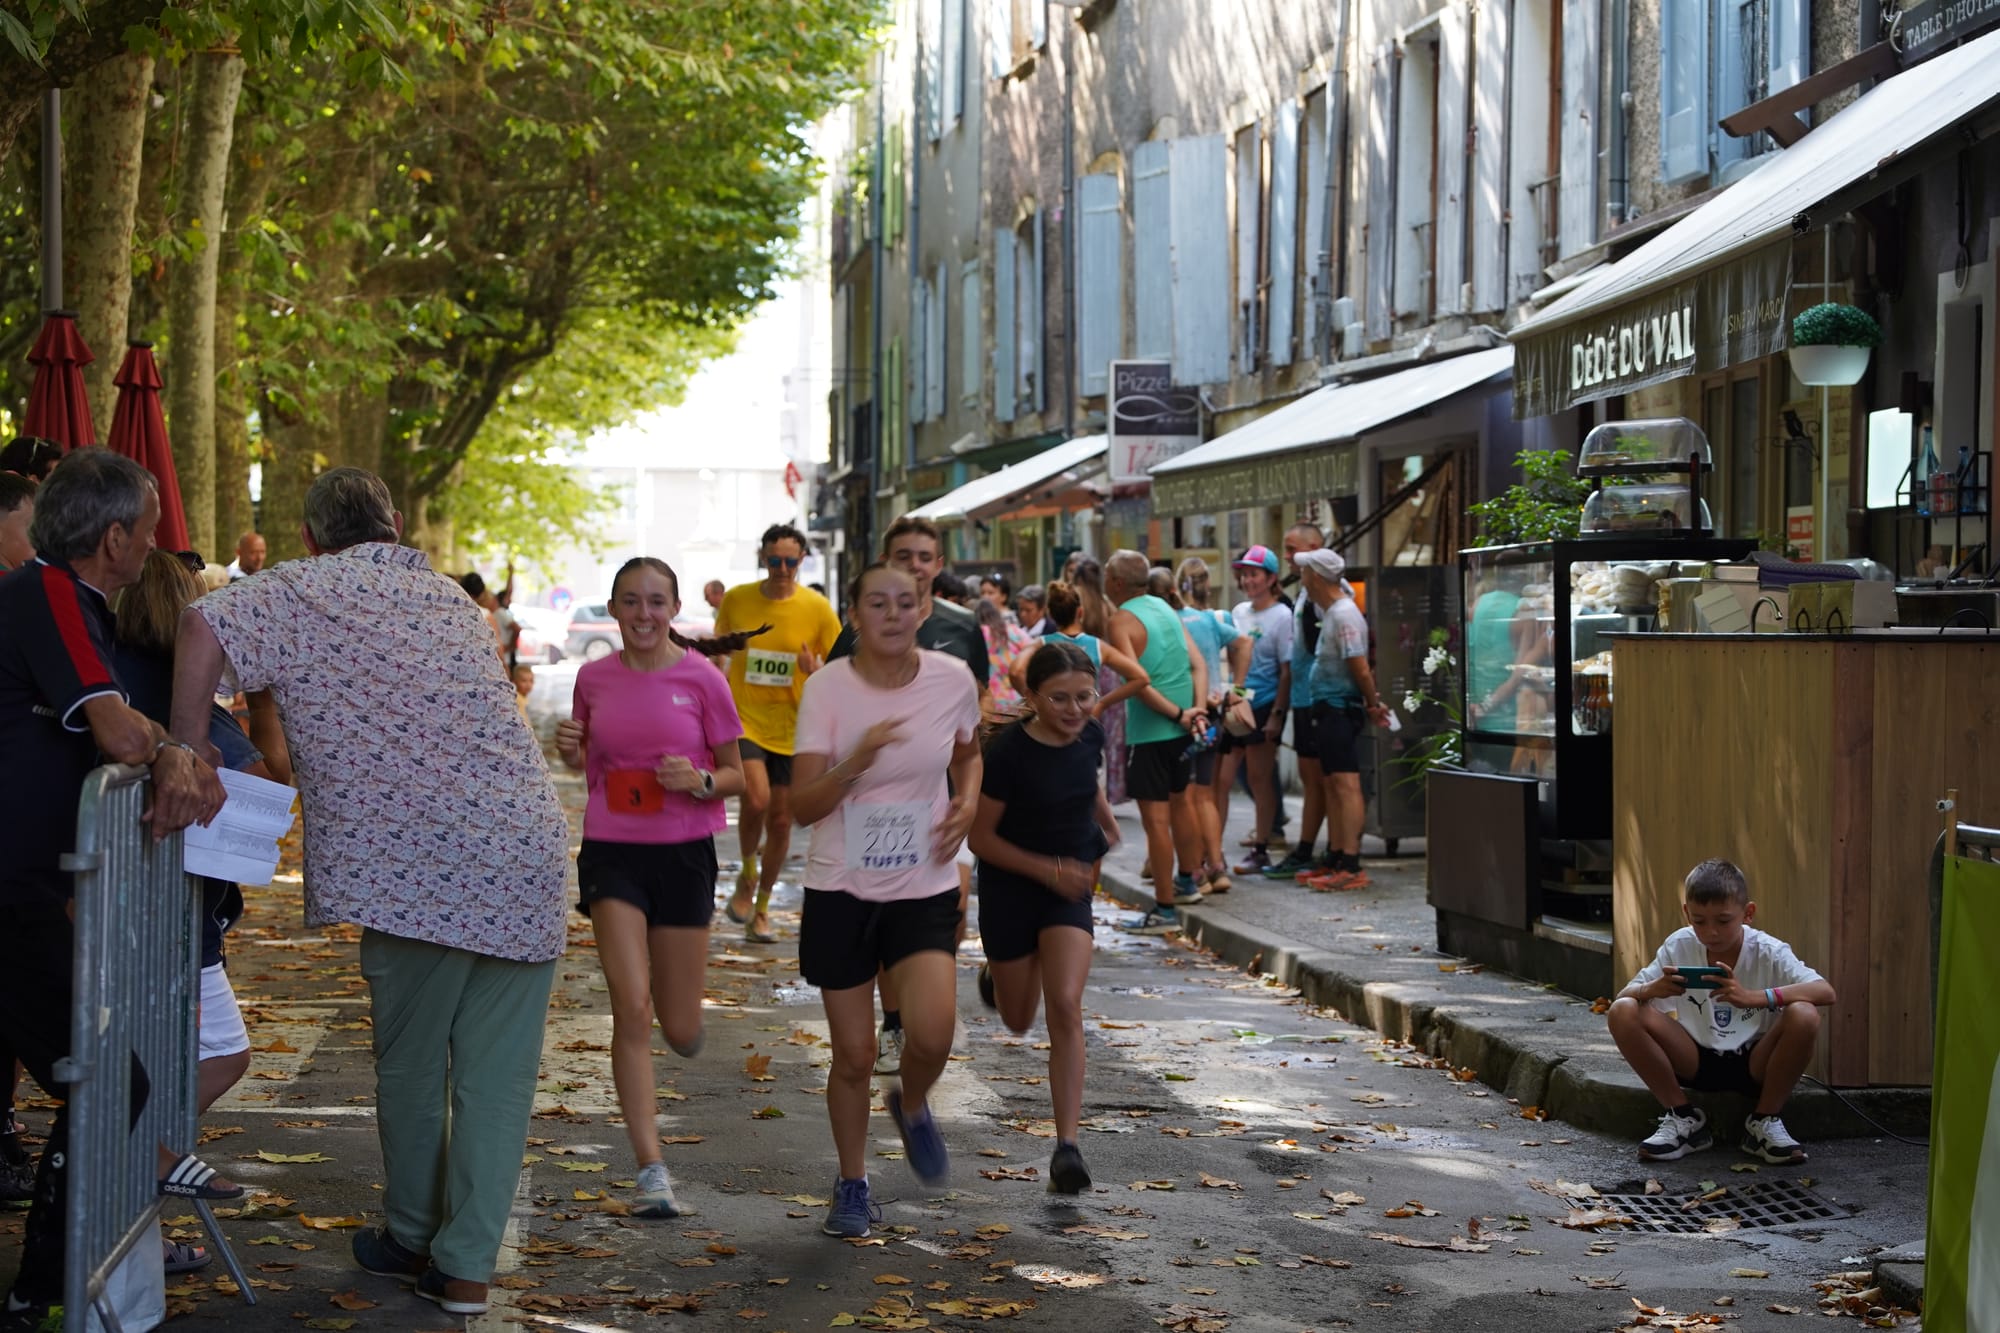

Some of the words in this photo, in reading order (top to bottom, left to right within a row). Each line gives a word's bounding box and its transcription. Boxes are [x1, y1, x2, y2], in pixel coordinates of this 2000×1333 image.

[1906, 13, 1943, 49] TABLE
[1571, 326, 1616, 391] DÉDÉ
[1619, 321, 1648, 376] DU
[1652, 307, 1695, 366] VAL
[754, 659, 789, 675] 100
[864, 829, 919, 853] 202
[164, 1184, 197, 1195] adidas
